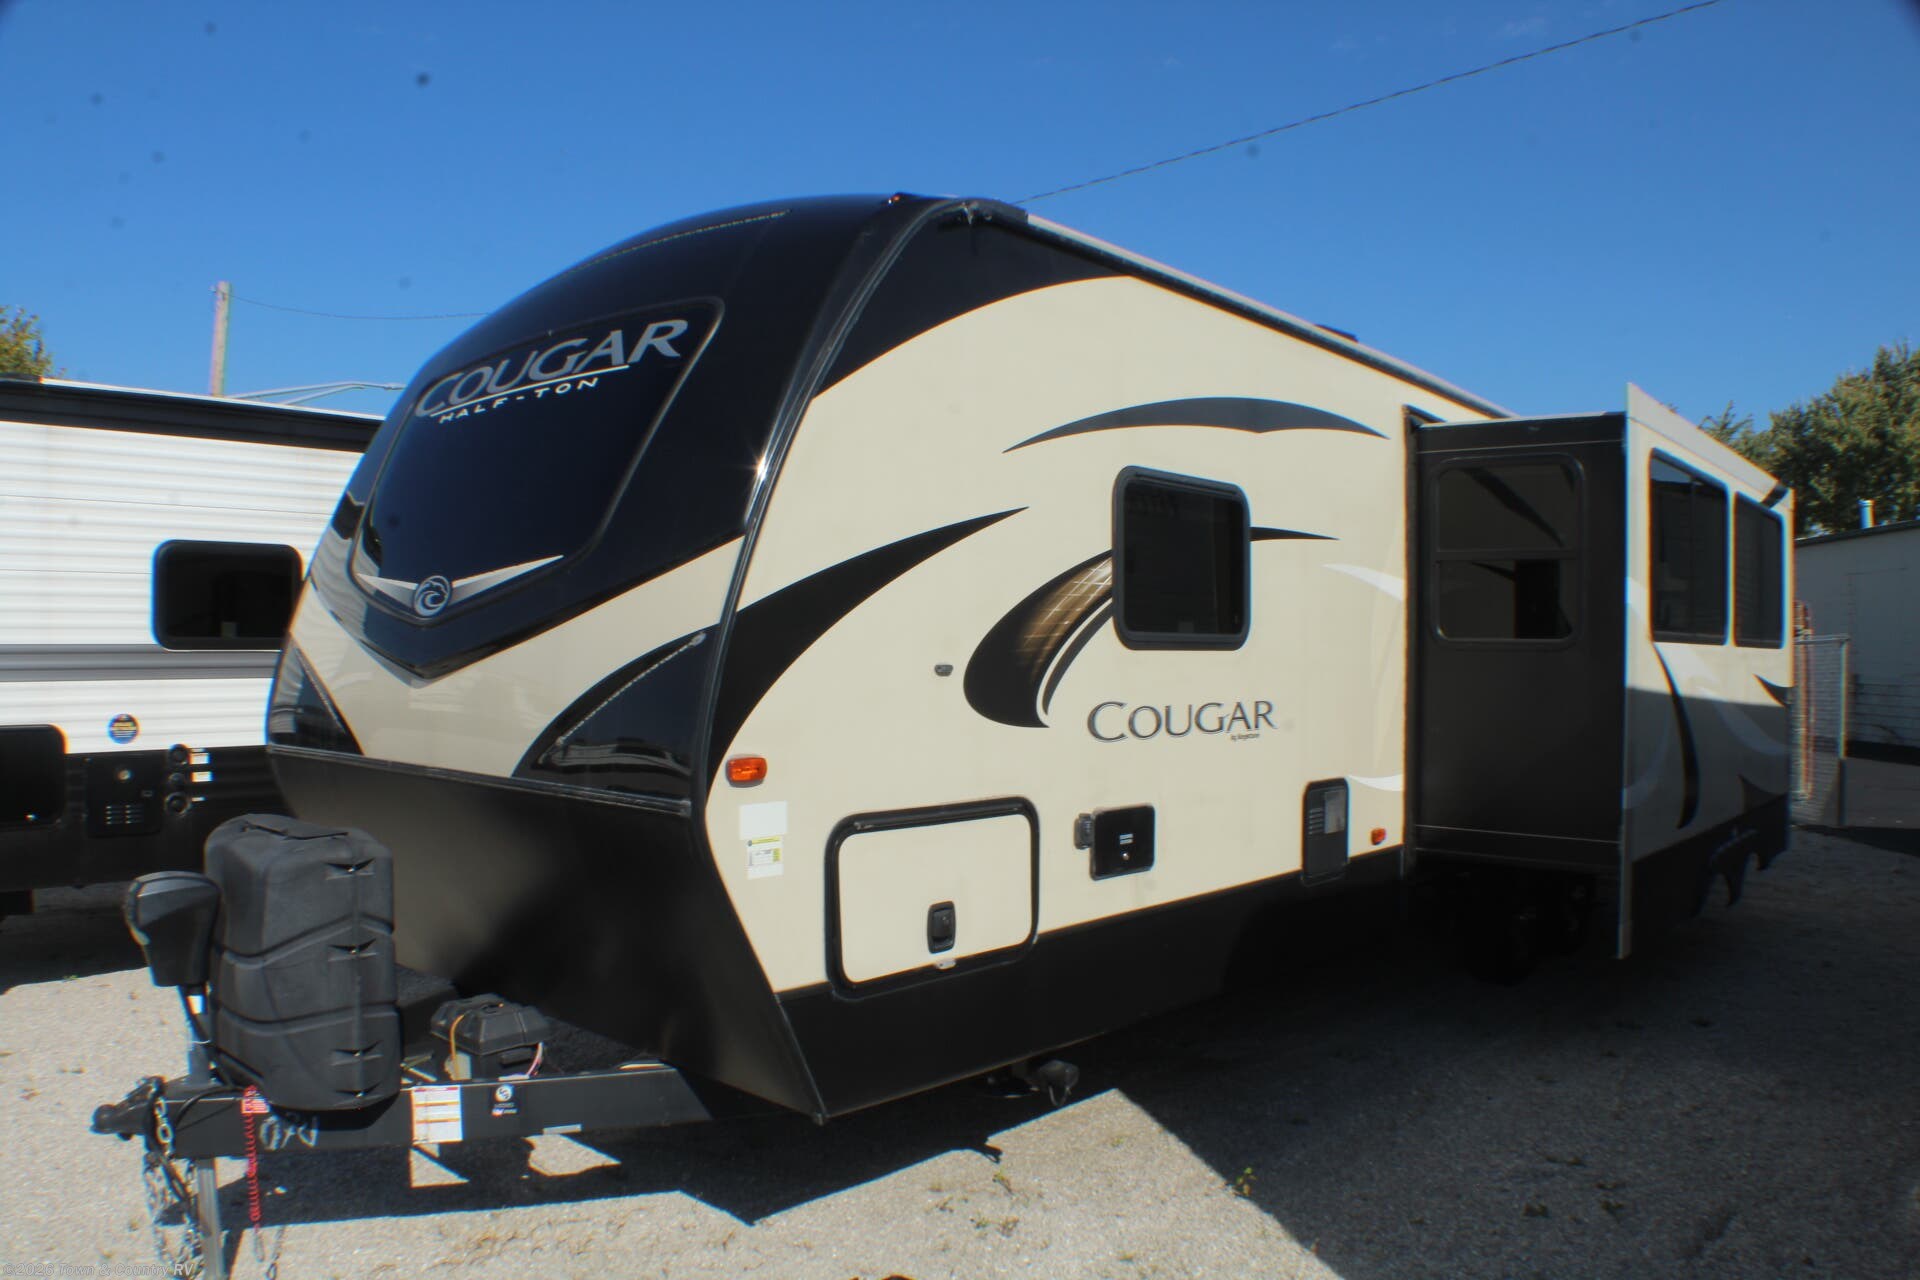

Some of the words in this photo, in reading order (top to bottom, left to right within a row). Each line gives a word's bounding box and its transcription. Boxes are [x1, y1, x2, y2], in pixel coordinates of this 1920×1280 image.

[415, 319, 688, 417] COUGAR
[438, 377, 599, 424] HALF-TON
[1087, 701, 1278, 742] COUGAR
